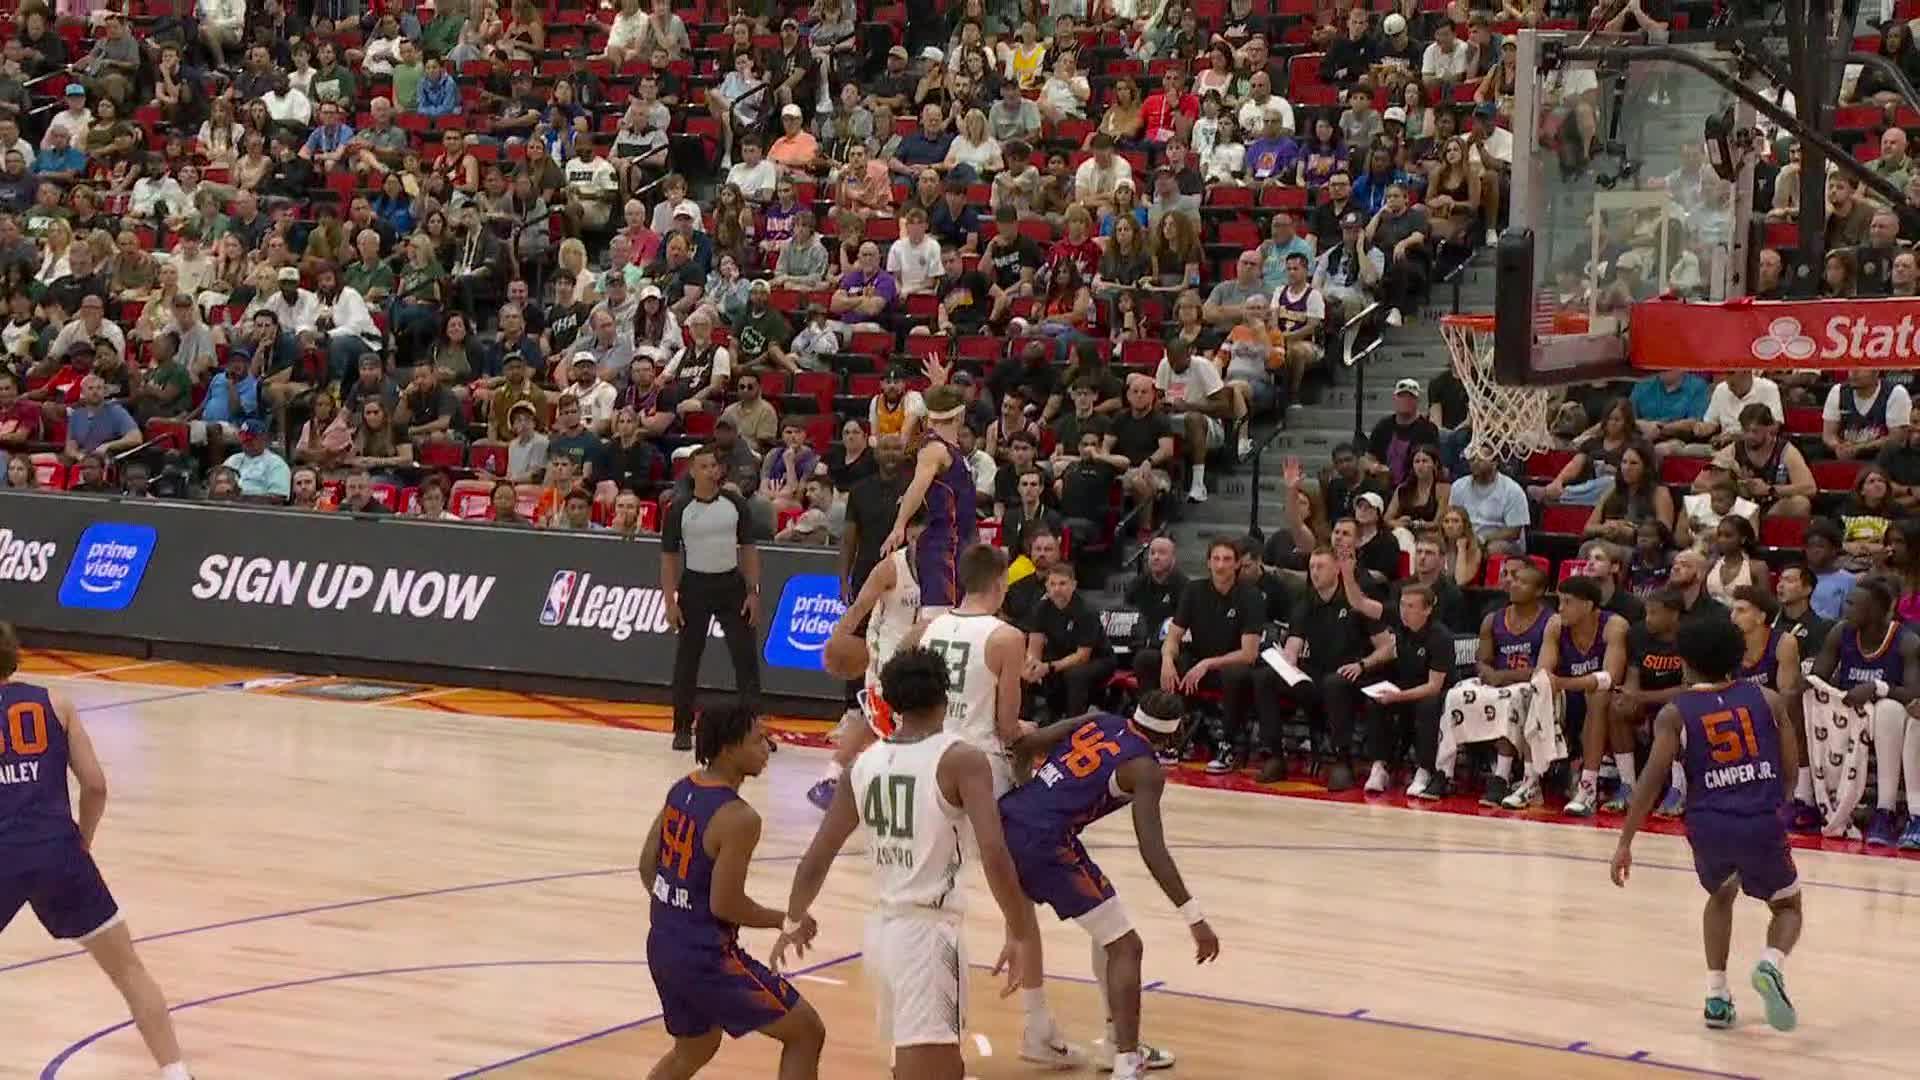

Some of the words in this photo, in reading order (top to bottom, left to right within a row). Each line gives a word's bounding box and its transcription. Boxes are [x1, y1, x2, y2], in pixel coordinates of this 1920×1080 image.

[84, 560, 130, 578] video
[88, 541, 138, 561] prime
[191, 553, 307, 605] SIGN
[307, 562, 374, 611] UP
[372, 568, 497, 621] NOW
[1058, 721, 1121, 778] 46
[1702, 706, 1760, 764] 51
[1704, 764, 1755, 789] CAMPER
[1757, 761, 1777, 779] JR.
[863, 774, 917, 838] 40
[662, 806, 696, 880] 54
[671, 886, 693, 910] JR.
